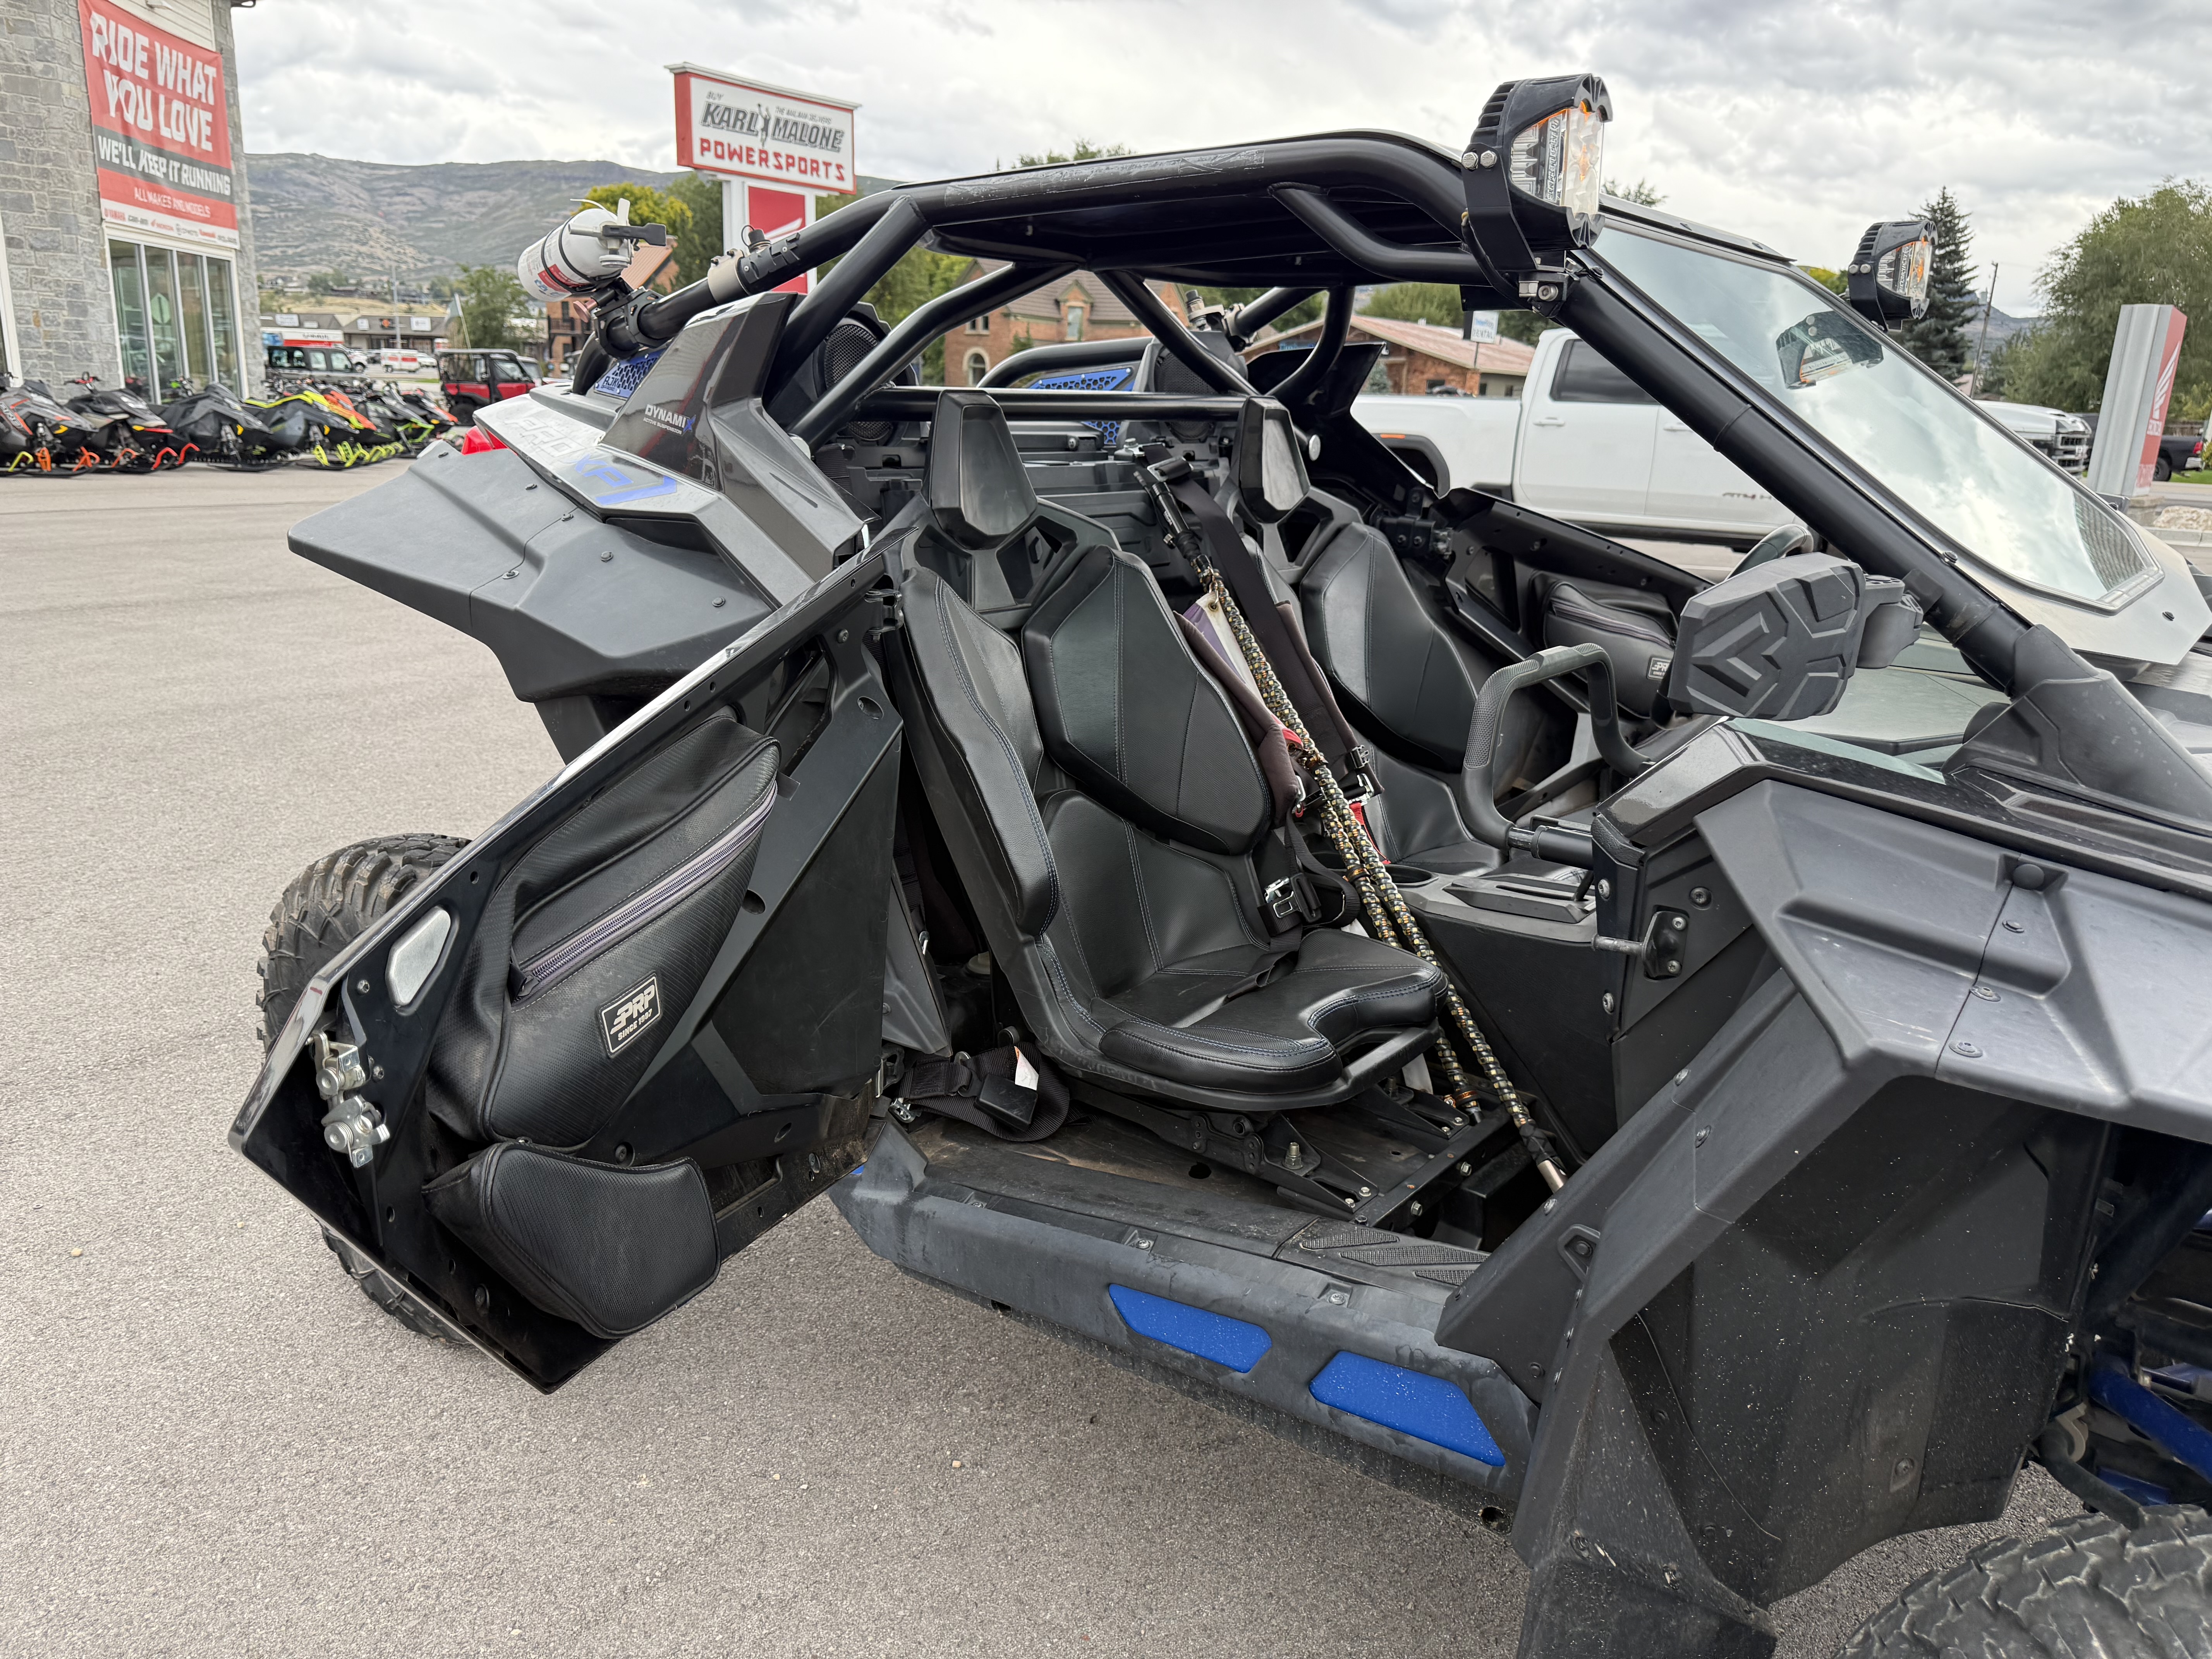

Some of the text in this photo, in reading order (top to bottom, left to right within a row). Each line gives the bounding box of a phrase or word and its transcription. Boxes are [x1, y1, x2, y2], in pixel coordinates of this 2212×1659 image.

[90, 11, 217, 105] RIDE WHAT
[103, 69, 213, 152] YOU LOVE
[700, 101, 845, 153] KARL MALONE
[98, 135, 231, 196] WE'LL KEEP IT RUNNING
[700, 137, 845, 182] POWERSPORTS
[134, 186, 148, 203] ALL
[147, 190, 172, 209] MAKES
[643, 417, 682, 435] ACTIVE SUSPENSION
[645, 404, 696, 433] DYNAMIX
[1651, 661, 1670, 672] PR
[610, 984, 655, 1035] PRP
[618, 1020, 637, 1041] SINCE
